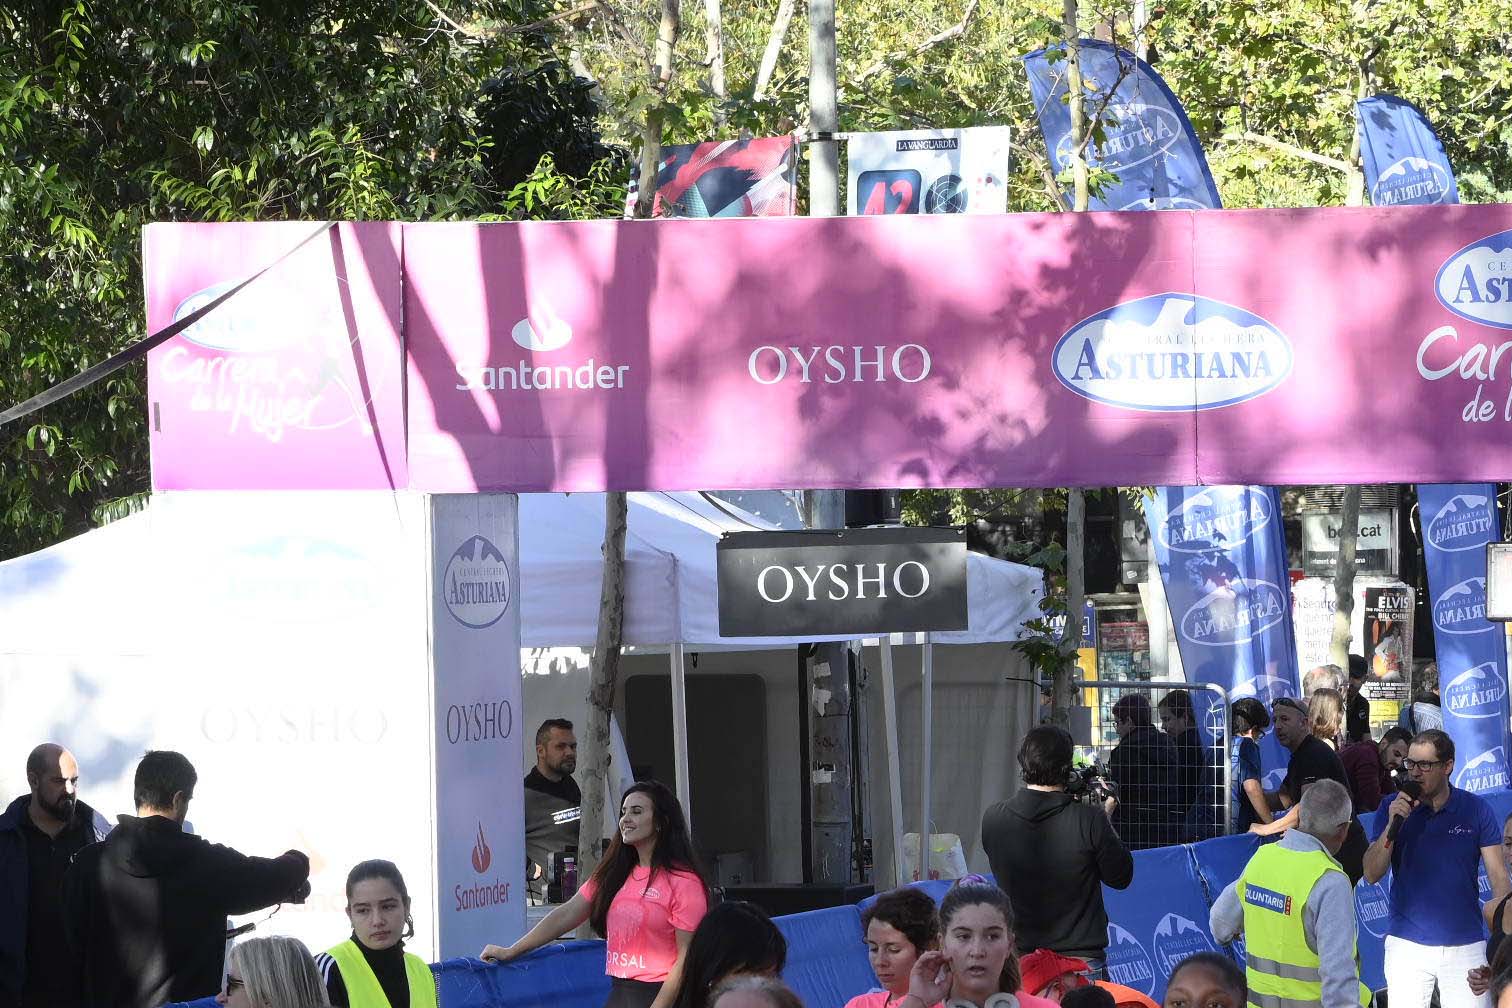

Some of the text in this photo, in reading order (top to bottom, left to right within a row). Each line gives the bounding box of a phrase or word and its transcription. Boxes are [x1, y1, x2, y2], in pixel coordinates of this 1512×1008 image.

[907, 139, 958, 150] VANGUARDIA
[455, 357, 630, 392] Santander
[747, 343, 932, 385] OYSHO
[1070, 336, 1274, 382] ASTURIANA
[1462, 382, 1497, 423] de
[449, 570, 507, 606] ASTURIANA
[757, 560, 930, 603] OYSHO
[1378, 596, 1409, 609] ELVIS
[446, 699, 513, 745] OYSHO
[454, 880, 511, 913] Santander
